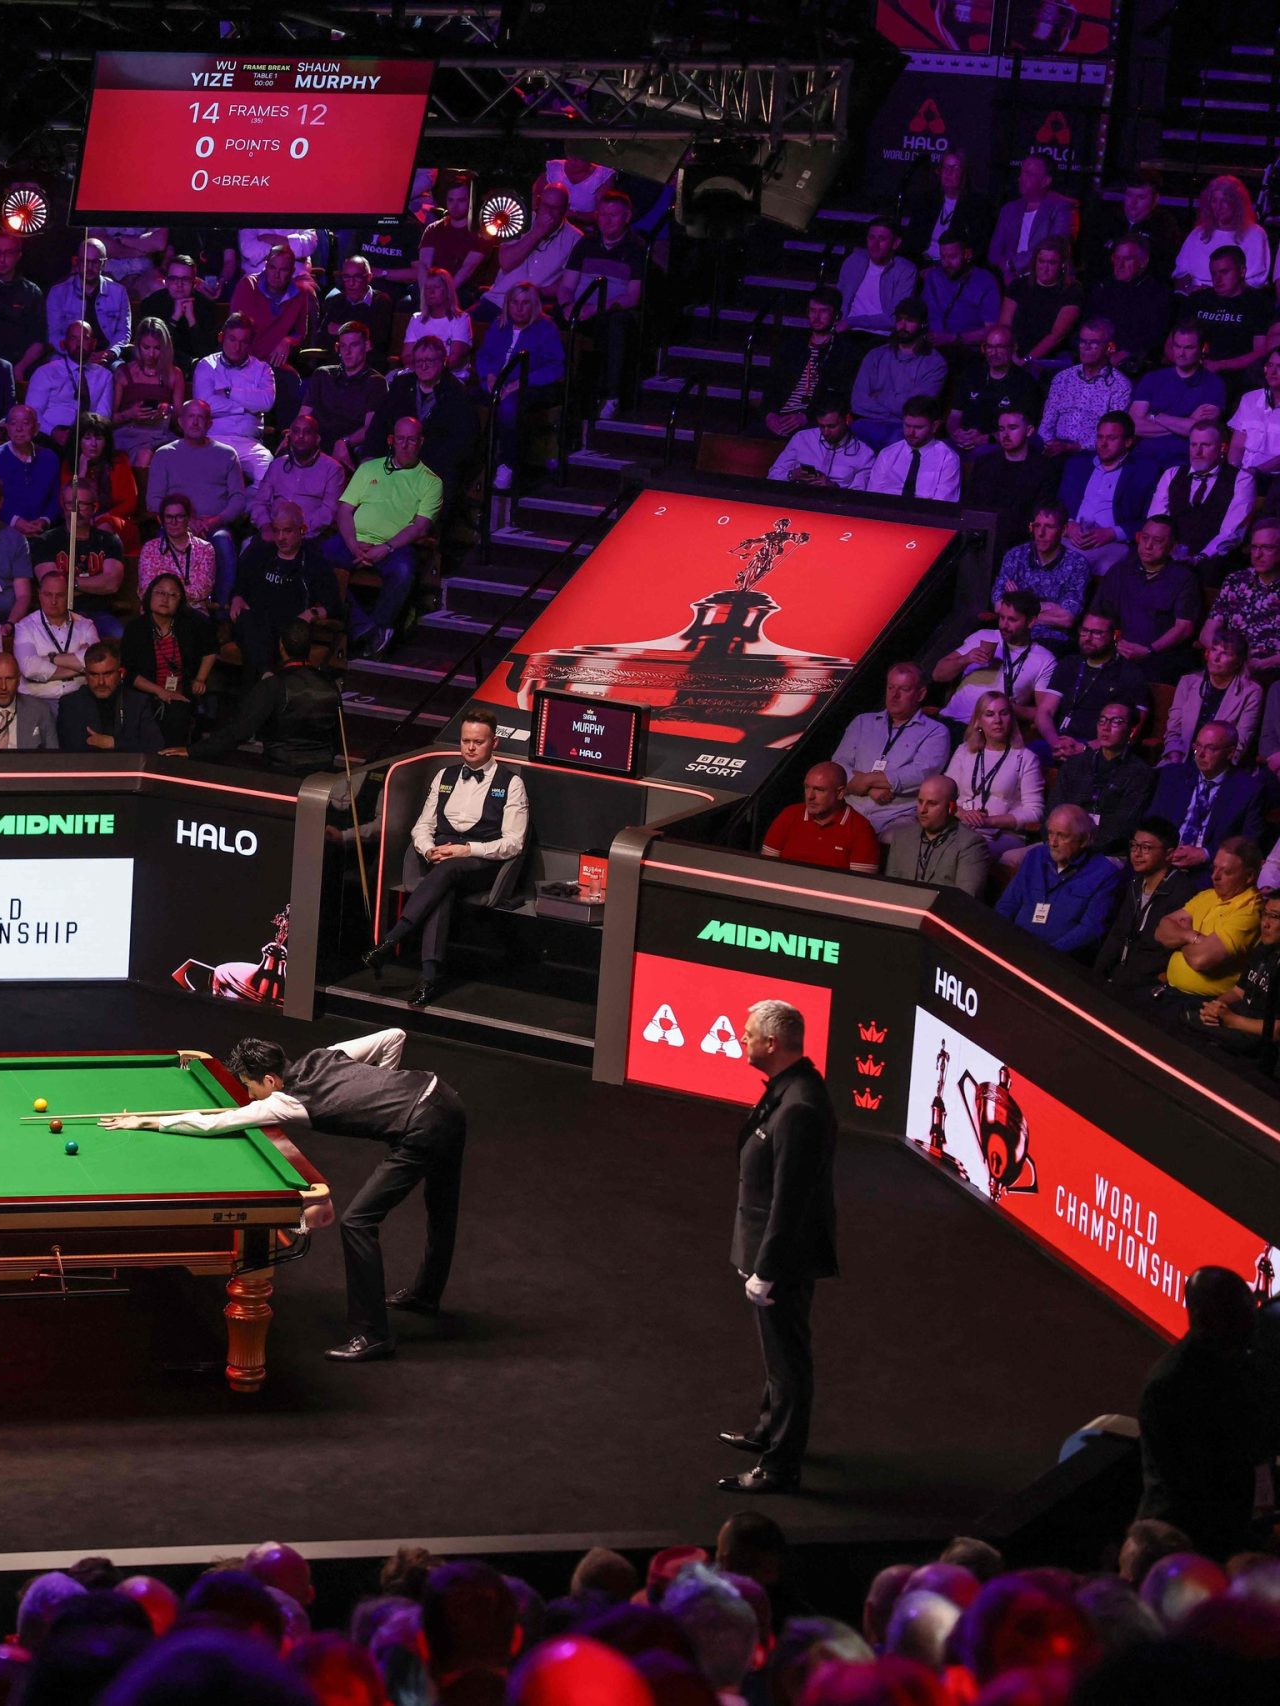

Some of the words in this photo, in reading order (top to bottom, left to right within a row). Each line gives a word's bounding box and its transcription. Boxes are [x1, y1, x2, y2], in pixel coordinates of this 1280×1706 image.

[216, 61, 237, 71] WU
[297, 62, 340, 73] SHAUN
[191, 73, 234, 87] YIZE
[294, 74, 381, 90] MURPHY
[188, 102, 220, 124] 14
[228, 104, 290, 118] FRAMES
[296, 104, 328, 126] 12
[195, 135, 215, 158] 0
[224, 139, 281, 151] POINTS
[289, 137, 309, 160] 0
[903, 135, 948, 151] HALO
[191, 169, 208, 191] 0
[221, 175, 270, 187] BREAK
[1196, 310, 1244, 323] CRUCIBLE
[572, 720, 605, 736] MURPHY
[579, 749, 602, 759] HALO
[696, 754, 747, 769] BBC
[685, 763, 742, 778] SPORT
[176, 819, 258, 857] HALO
[697, 919, 840, 965] MIDNITE
[935, 967, 978, 1018] HALO
[1095, 1173, 1158, 1246] WORLD
